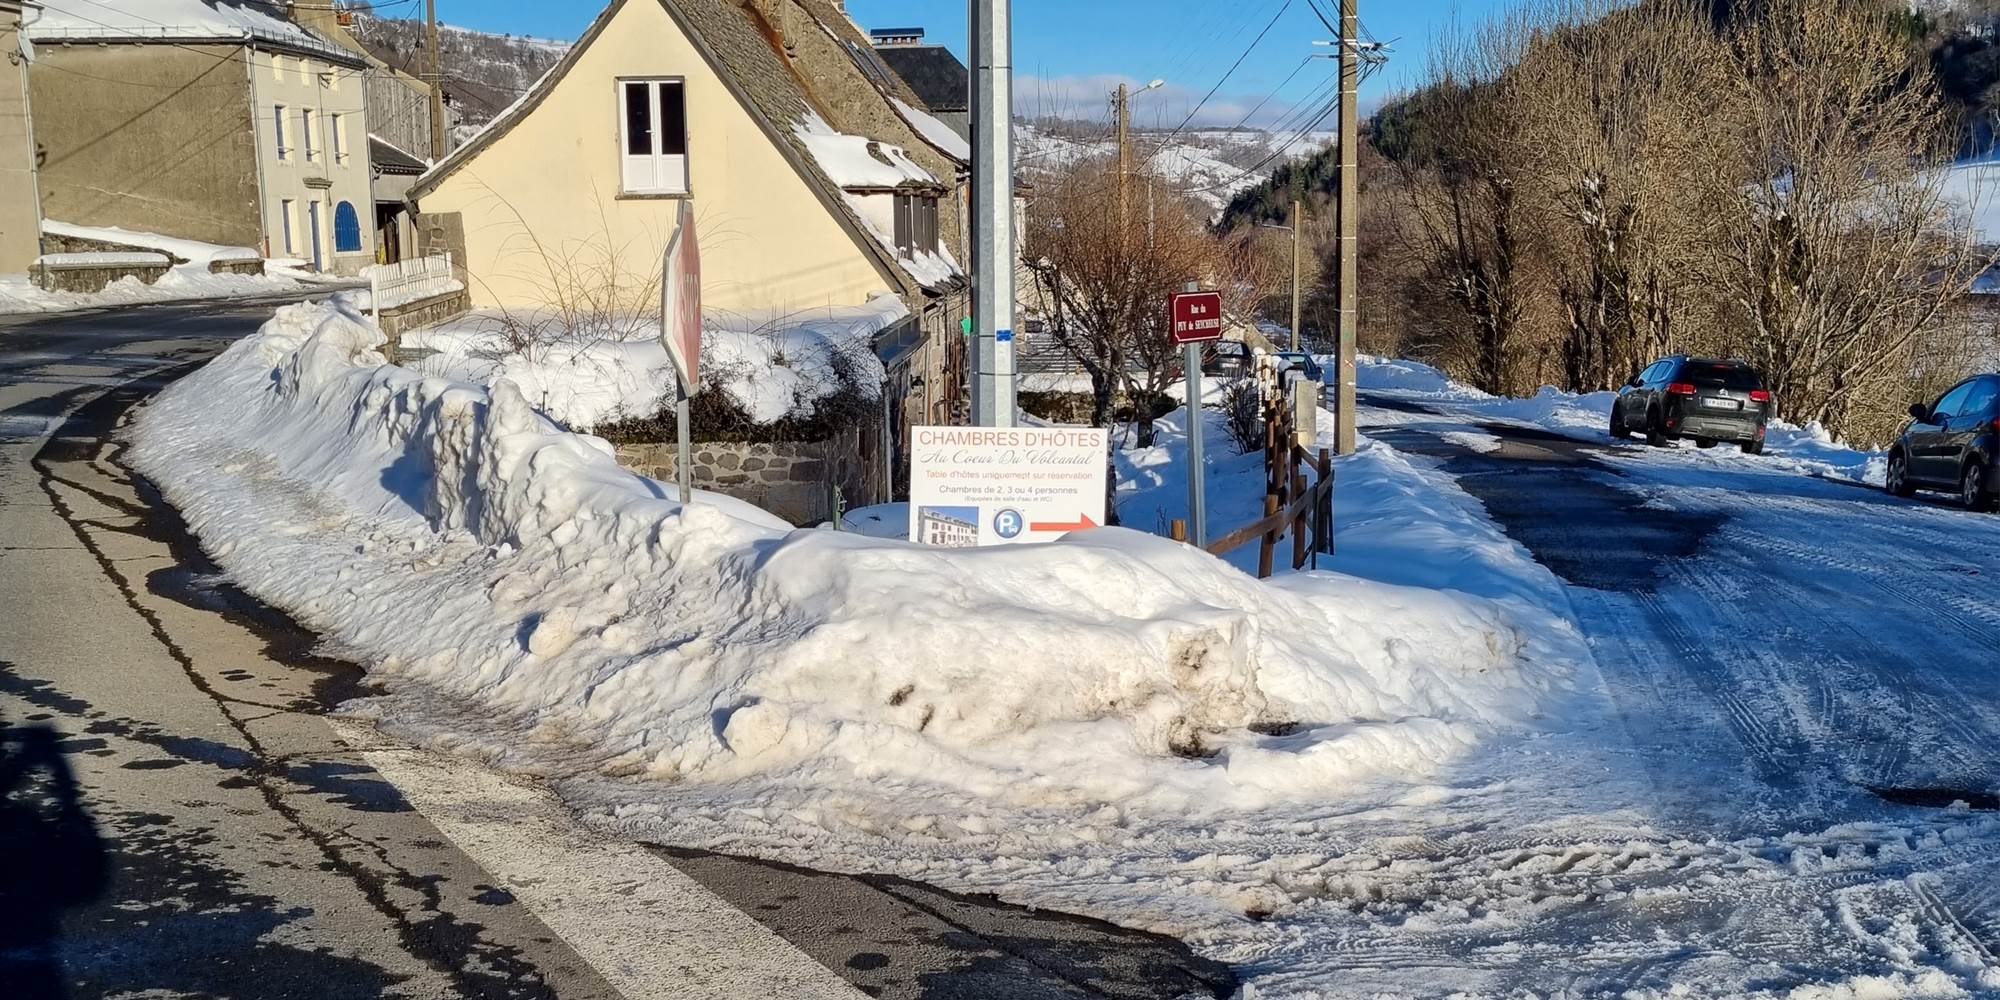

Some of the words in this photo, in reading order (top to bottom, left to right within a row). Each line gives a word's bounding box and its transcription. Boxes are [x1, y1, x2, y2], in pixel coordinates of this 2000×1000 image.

[680, 273, 699, 322] STOP
[1200, 304, 1206, 312] du
[1178, 321, 1186, 331] PUY
[1188, 321, 1194, 330] de
[919, 430, 1020, 447] CHAMBRES
[1025, 430, 1100, 447] D'HÔTES
[919, 449, 948, 463] Au
[952, 449, 994, 463] Coeur
[998, 449, 1022, 464] Du
[1025, 449, 1096, 465] Volcantal
[926, 470, 948, 479] Table
[950, 470, 980, 479] d'hôtes
[939, 485, 982, 494] Chambres
[984, 485, 994, 494] de
[1007, 486, 1013, 494] 3
[1027, 486, 1033, 494] 4
[1034, 487, 1079, 495] personnes
